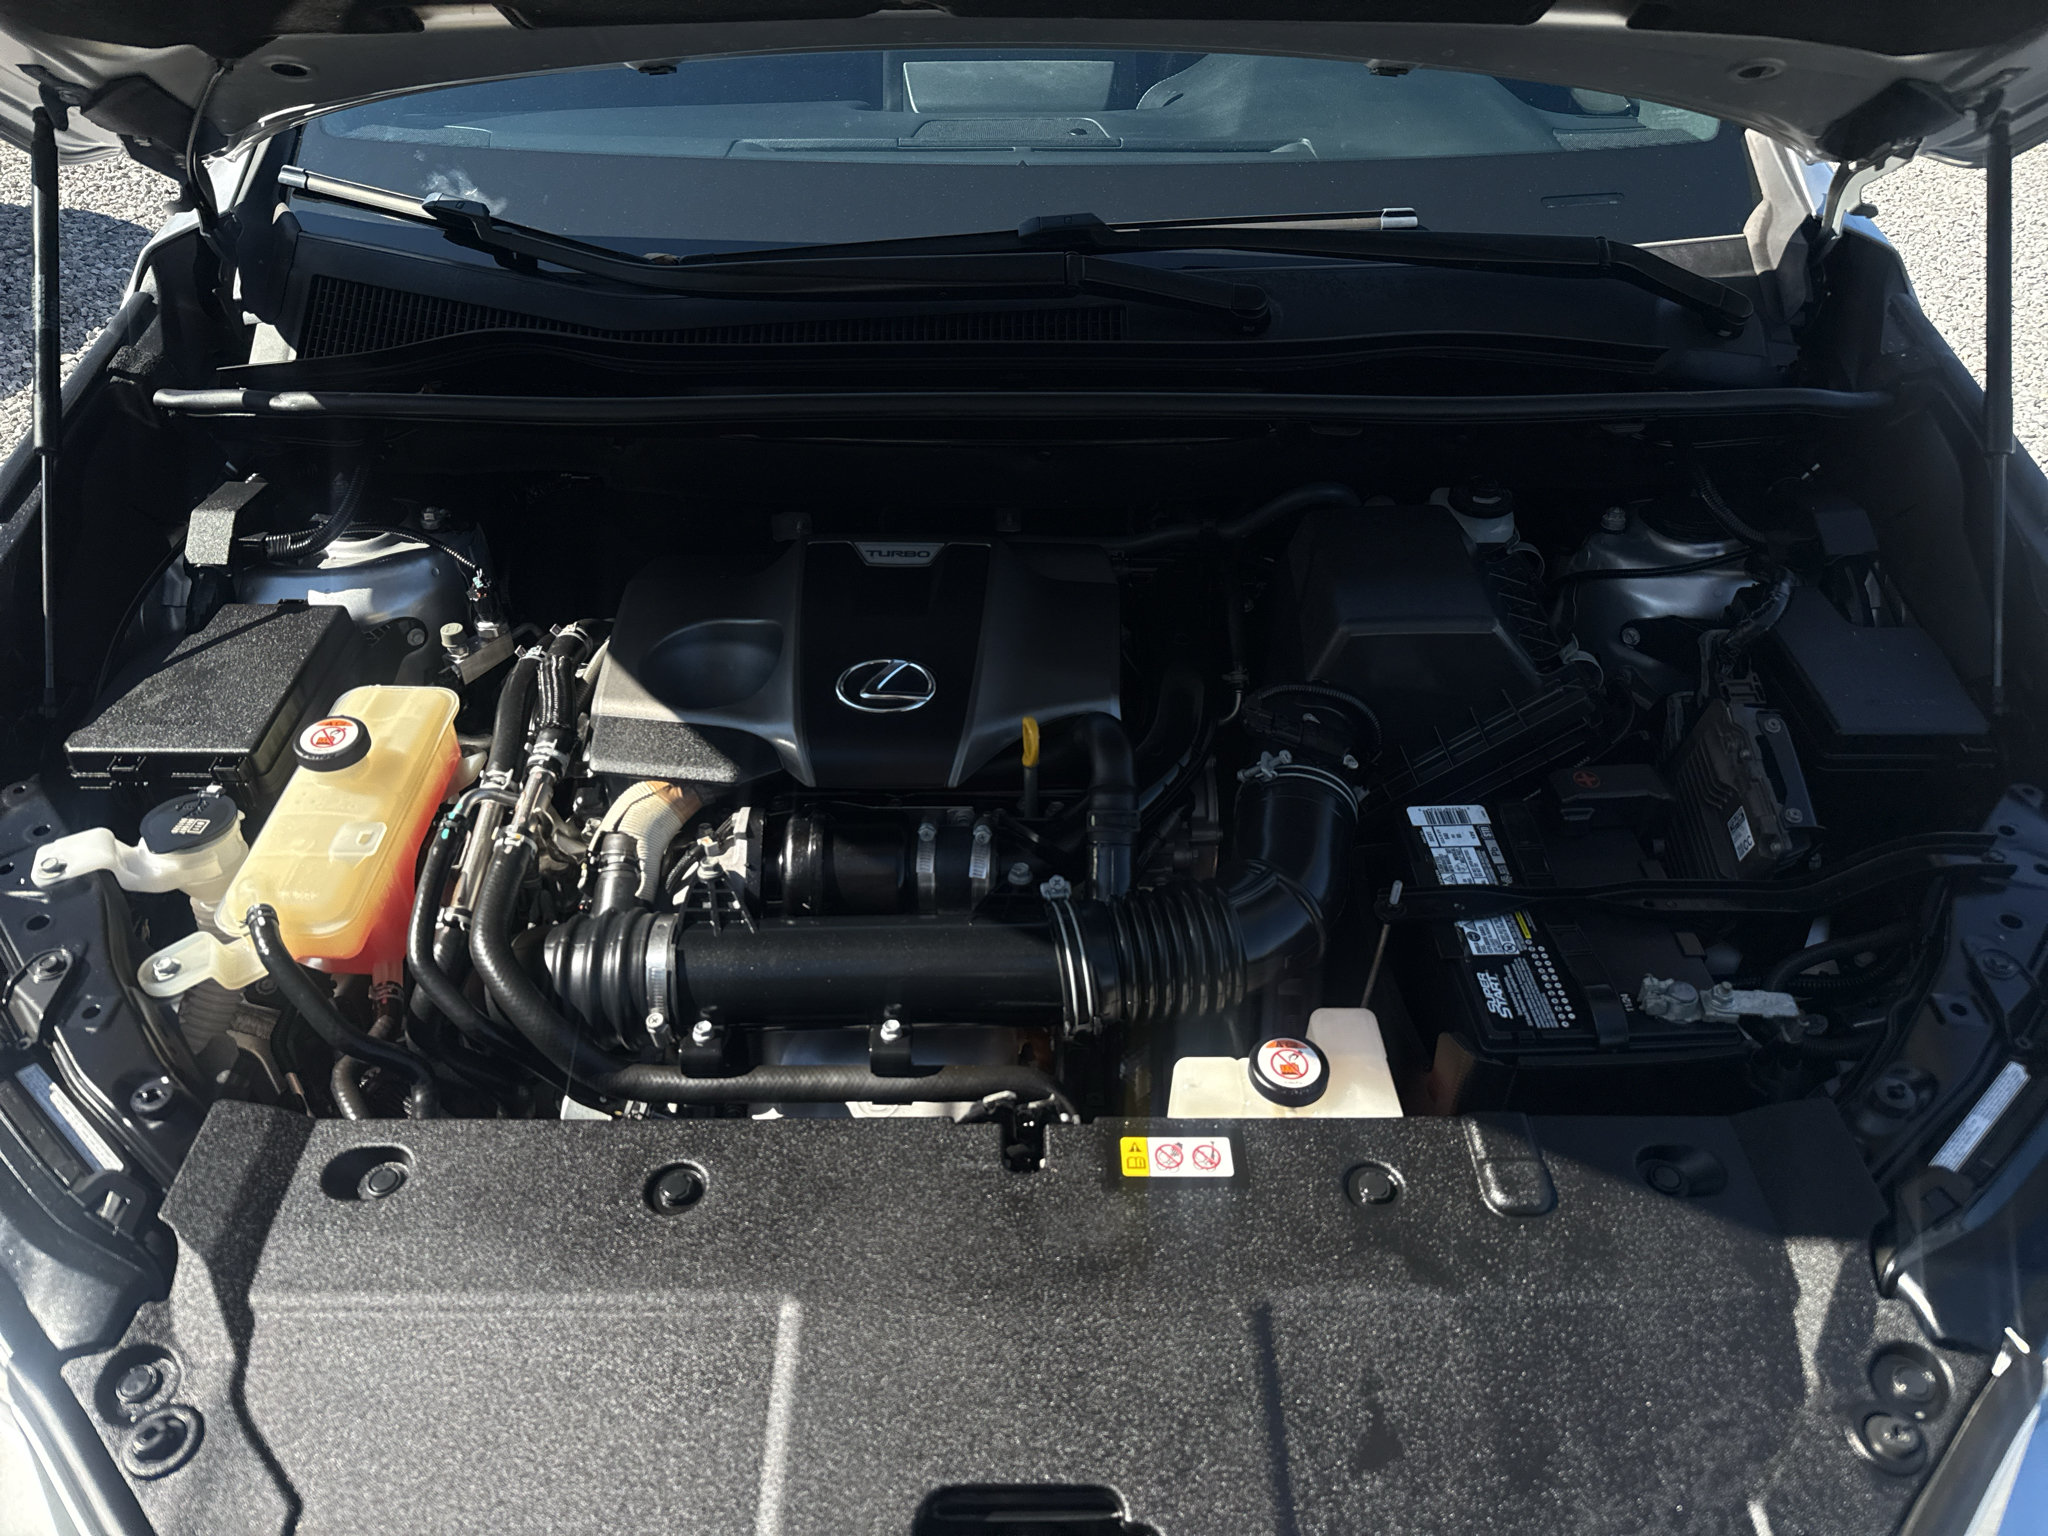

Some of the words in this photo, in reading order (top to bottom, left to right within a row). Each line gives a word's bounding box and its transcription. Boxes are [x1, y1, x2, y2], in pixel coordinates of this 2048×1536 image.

[865, 549, 930, 558] TURBO
[1476, 971, 1498, 1013] SUPER
[1487, 972, 1513, 1020] START
